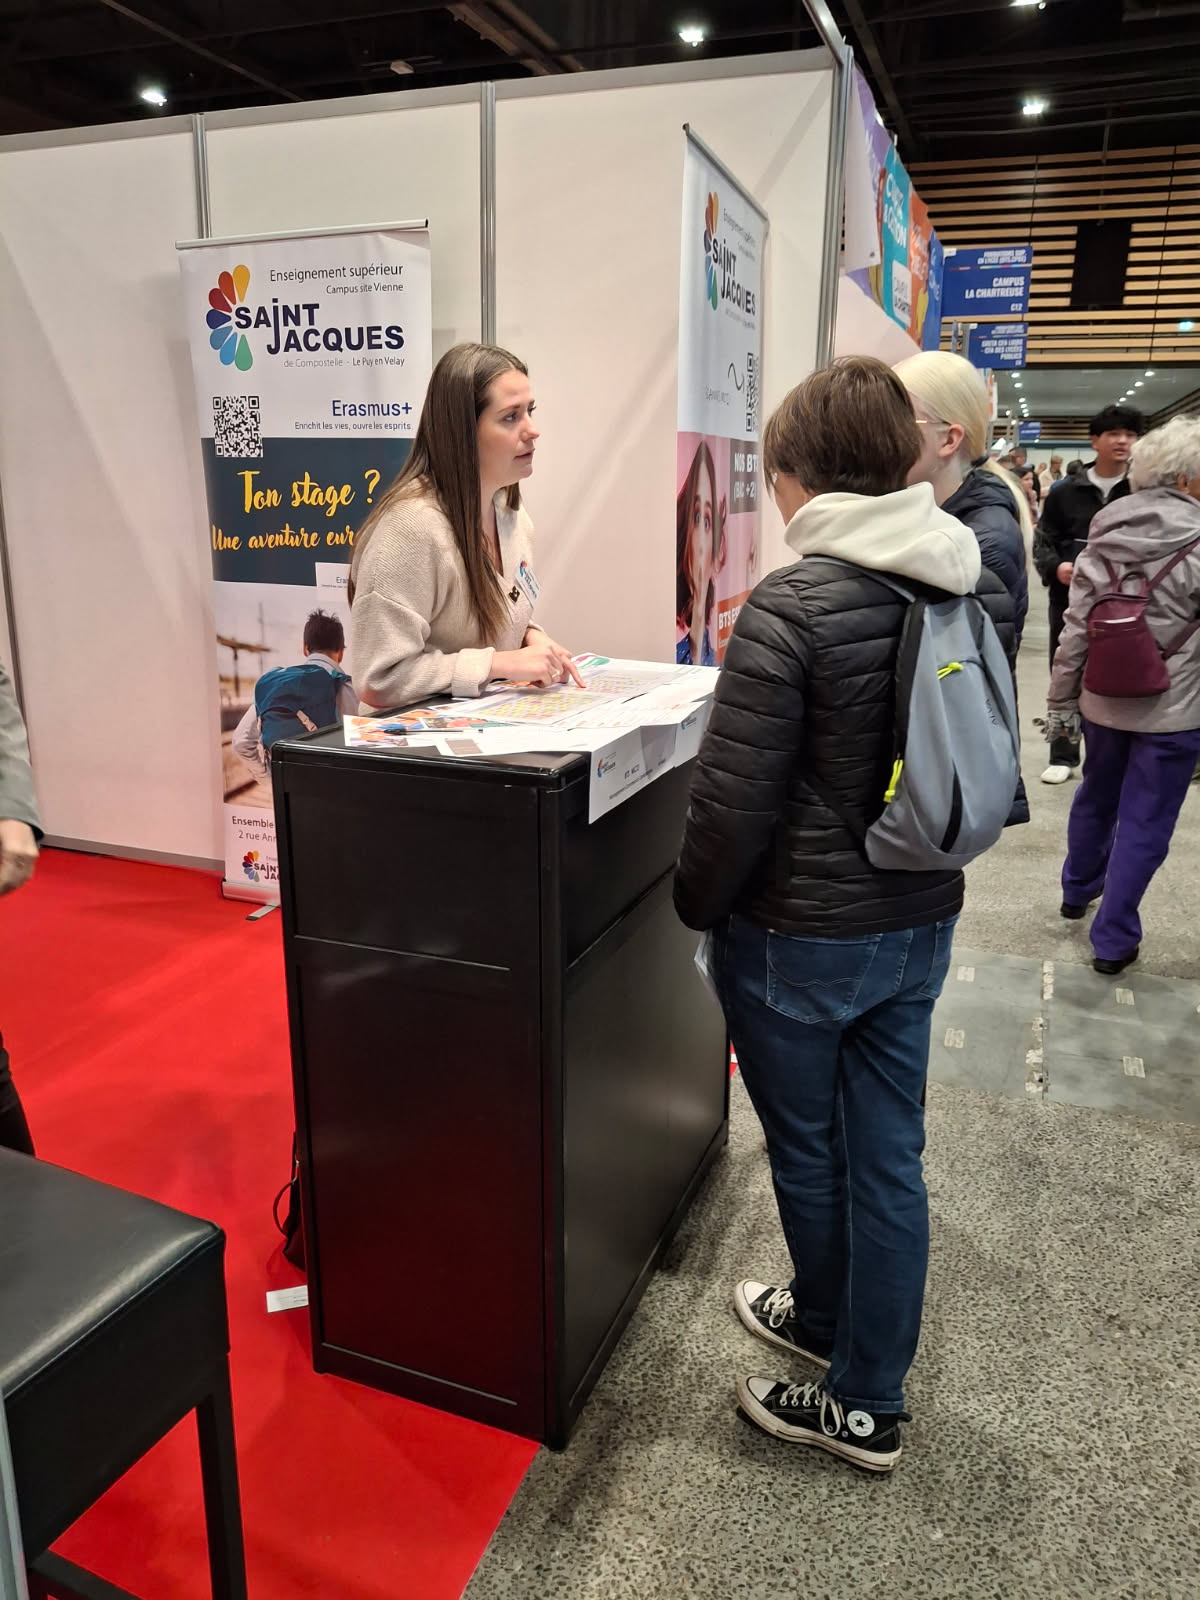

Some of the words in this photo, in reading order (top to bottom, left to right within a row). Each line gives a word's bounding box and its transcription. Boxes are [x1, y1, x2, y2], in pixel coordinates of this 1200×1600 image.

[270, 267, 346, 283] Enseignement
[349, 264, 404, 280] supérieur
[992, 276, 1025, 288] CAMPUS
[326, 284, 358, 296] Campus
[359, 283, 372, 293] site
[373, 283, 404, 293] Vienne
[965, 289, 976, 299] LA
[975, 286, 1024, 299] CHARTREUSE
[721, 276, 756, 317] JACQUES
[266, 325, 405, 355] JACQUES
[283, 358, 293, 368] de
[295, 357, 343, 369] Compostelle
[352, 357, 361, 366] Le
[362, 357, 374, 368] Puy
[375, 358, 383, 366] en
[384, 357, 405, 368] Velay
[332, 399, 412, 417] Erasmus+
[295, 421, 321, 430] Enrichit
[322, 421, 333, 430] les
[334, 422, 351, 431] vies,
[352, 422, 372, 430] ouvre
[373, 421, 383, 430] les
[237, 470, 282, 514] Ton
[291, 471, 356, 517] stage
[364, 469, 381, 504] ?
[212, 524, 243, 551] Une
[248, 523, 321, 549] aventure
[232, 816, 274, 828] Ensemble
[238, 830, 244, 839] 2
[246, 832, 260, 841] rue
